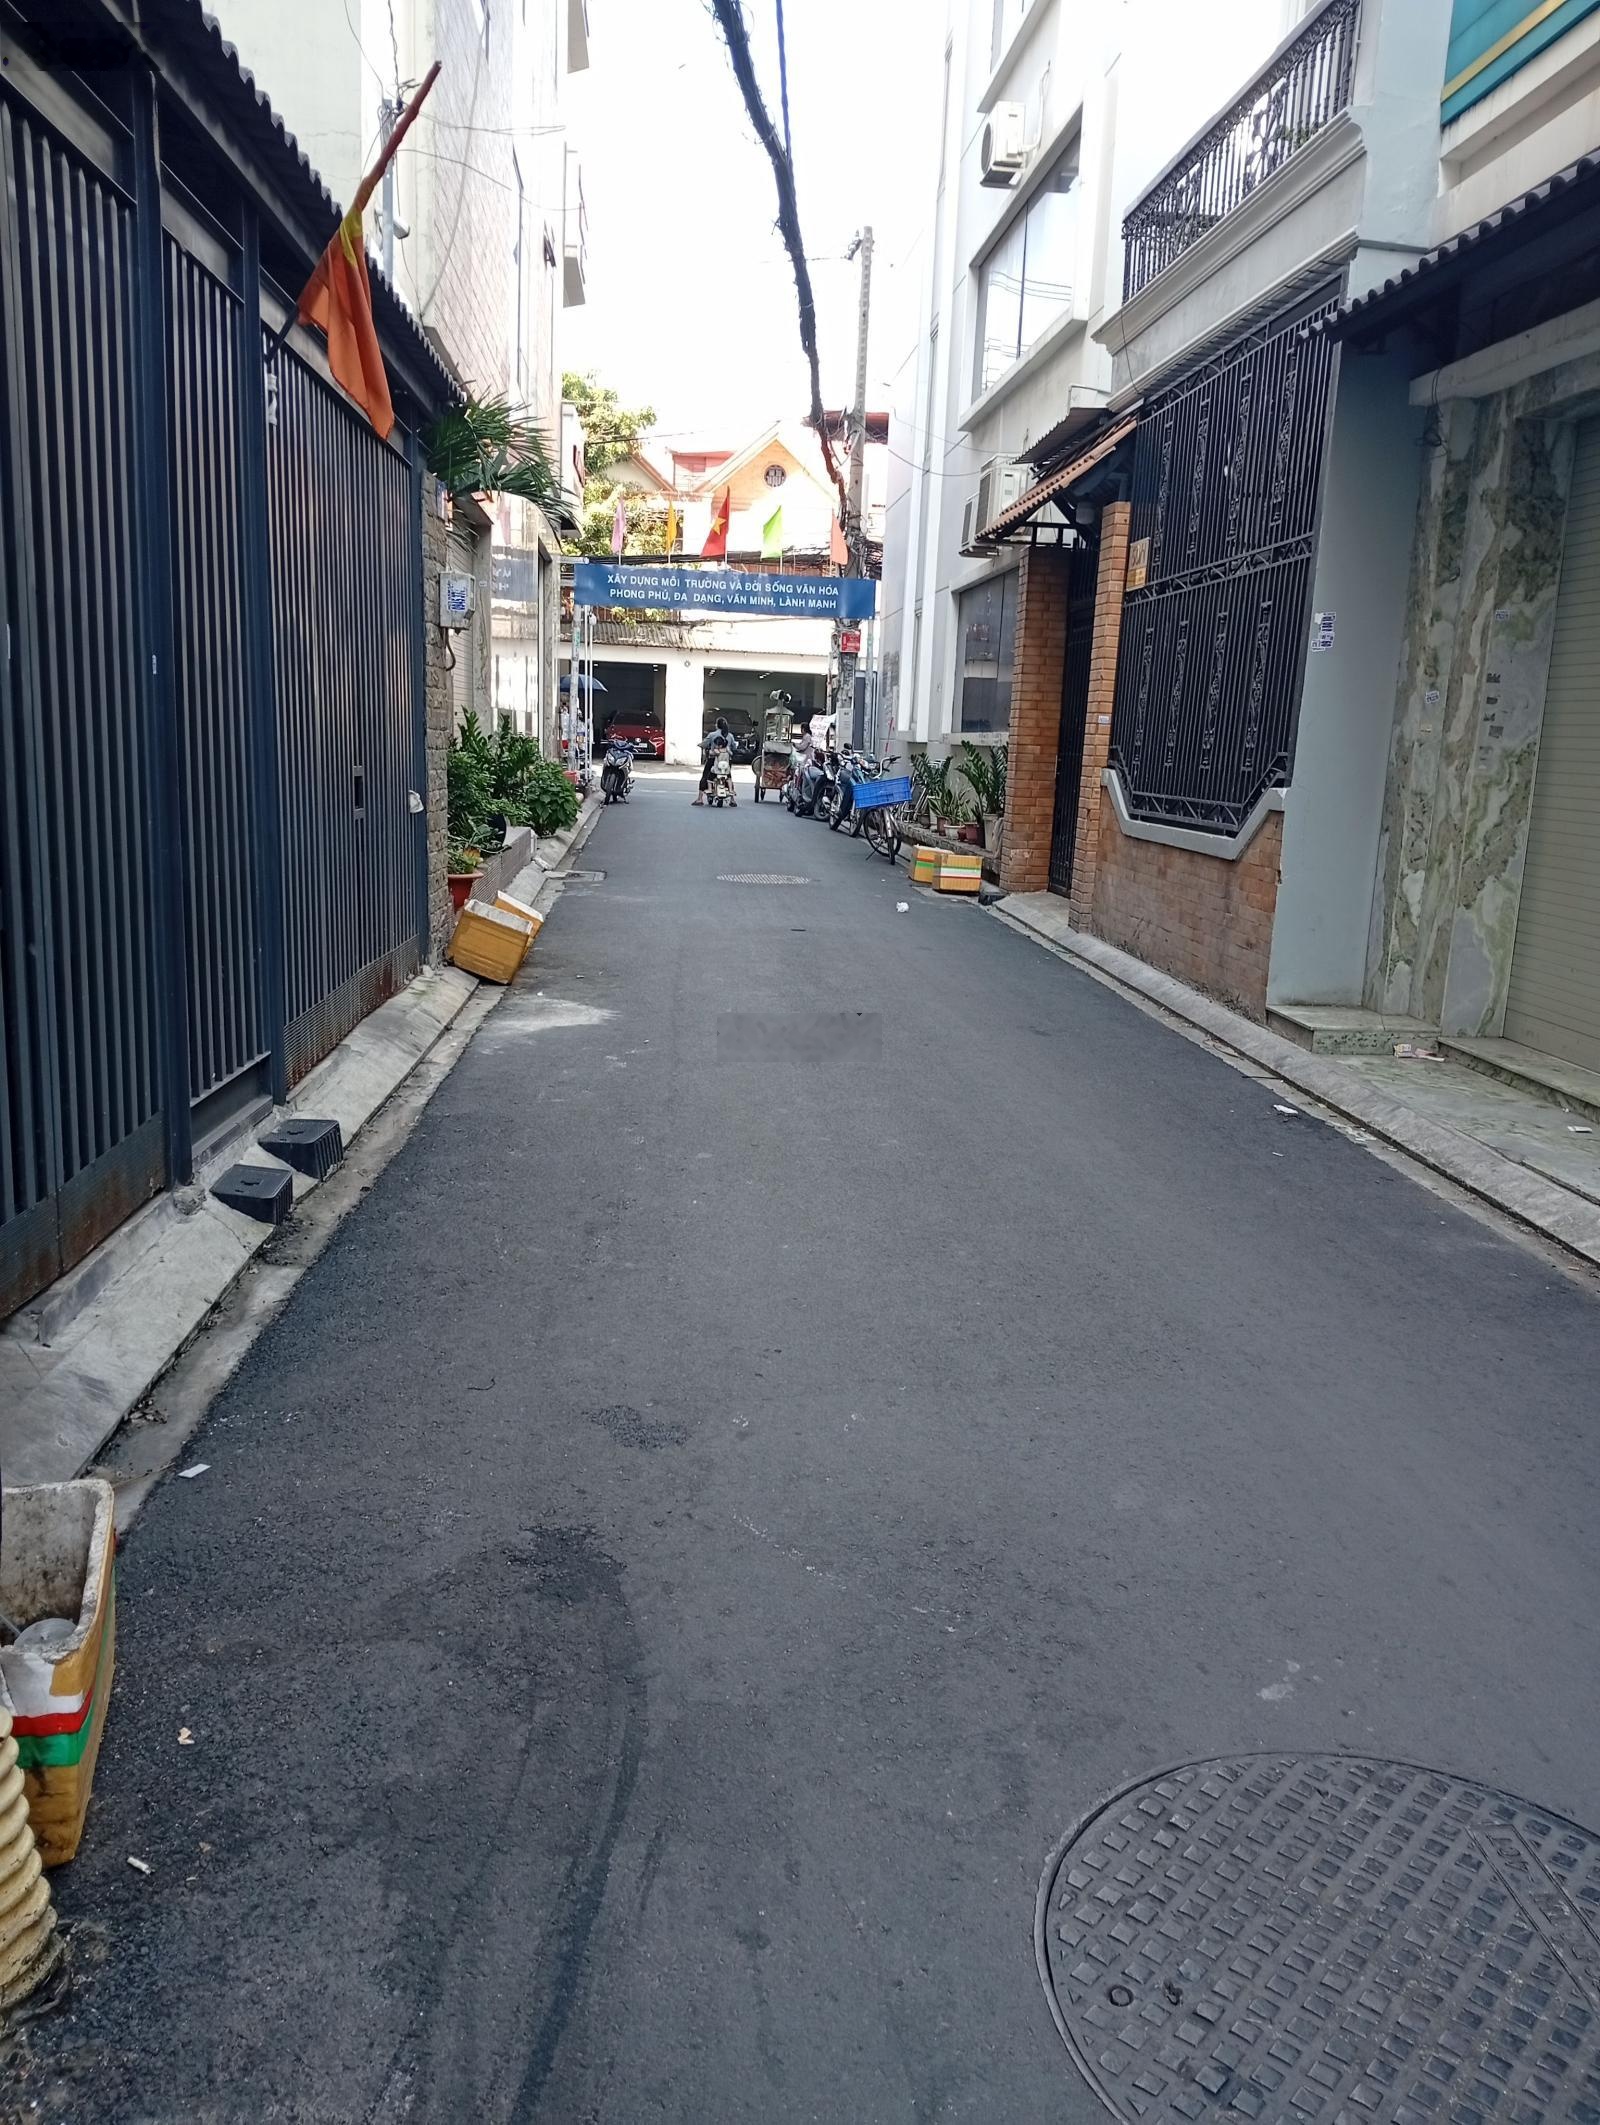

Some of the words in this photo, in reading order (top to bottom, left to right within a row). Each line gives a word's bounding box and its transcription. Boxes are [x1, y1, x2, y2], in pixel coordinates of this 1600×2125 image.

[607, 573, 628, 584] XÂY
[630, 575, 659, 587] DỰNG
[661, 575, 680, 587] MÔI
[684, 576, 727, 590] TRƯỜNG
[729, 579, 743, 591] VÀ
[745, 580, 762, 592] ĐỜI
[765, 580, 793, 593] SỐNG
[796, 583, 816, 594] VĂN
[818, 584, 839, 596] HÓA
[609, 588, 645, 600] PHONG
[648, 589, 671, 601] PHÚ,
[674, 592, 688, 601] ĐA
[693, 593, 725, 604] DẠNG,
[727, 593, 747, 605] VĂN
[749, 596, 776, 607] MINH,
[779, 597, 805, 608] LÀNH
[808, 599, 837, 610] MẠNH
